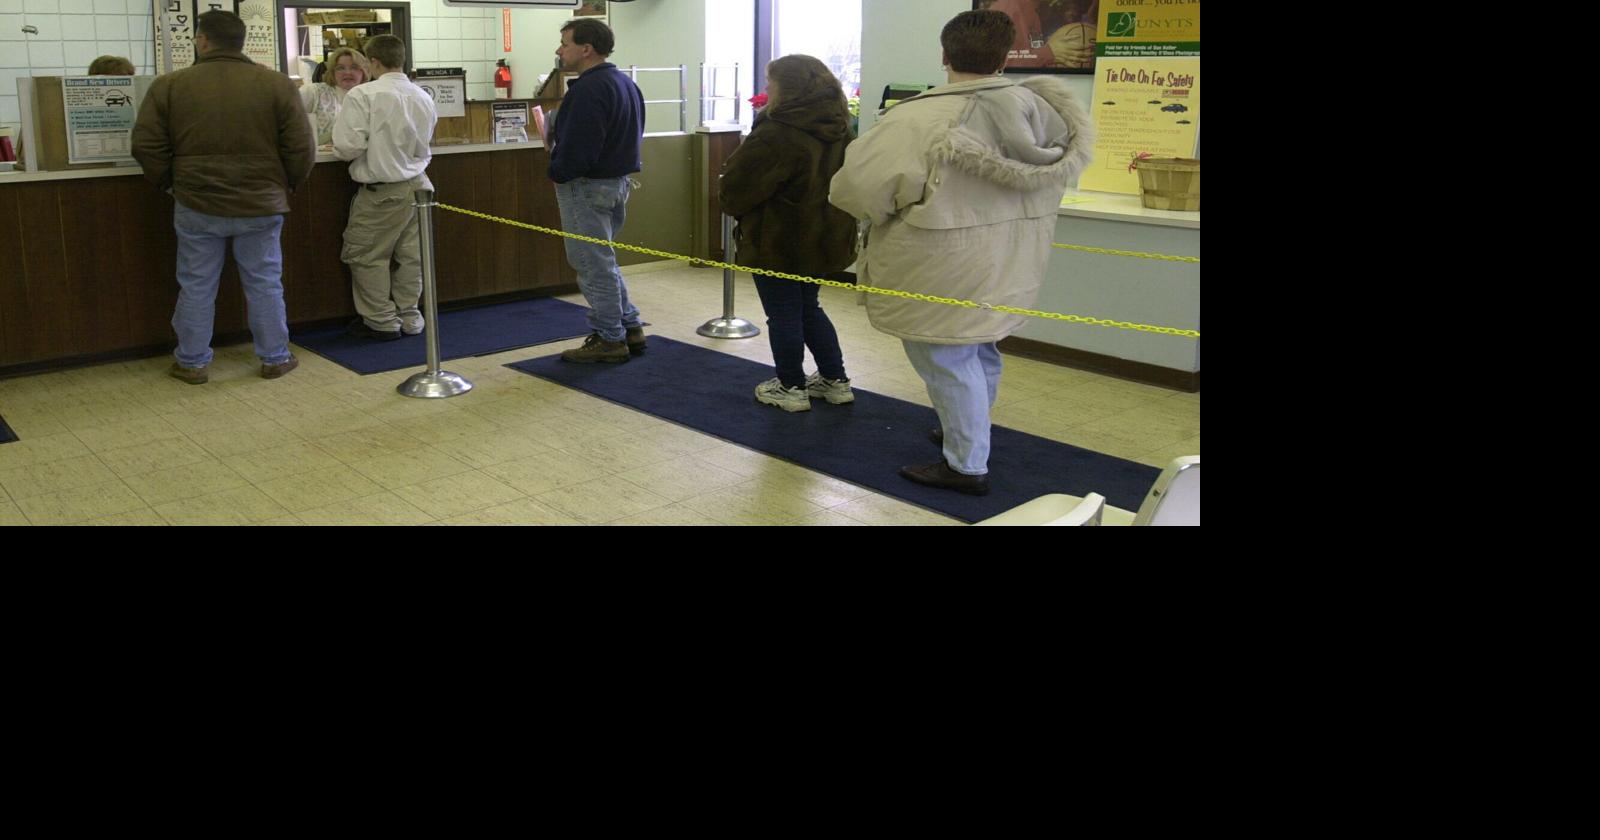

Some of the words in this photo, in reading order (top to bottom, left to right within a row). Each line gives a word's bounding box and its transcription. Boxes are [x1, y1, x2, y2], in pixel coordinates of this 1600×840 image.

[1106, 68, 1119, 83] Tie
[1120, 68, 1136, 83] One
[1138, 69, 1149, 84] On
[1151, 70, 1165, 86] For
[1166, 72, 1194, 88] Safety
